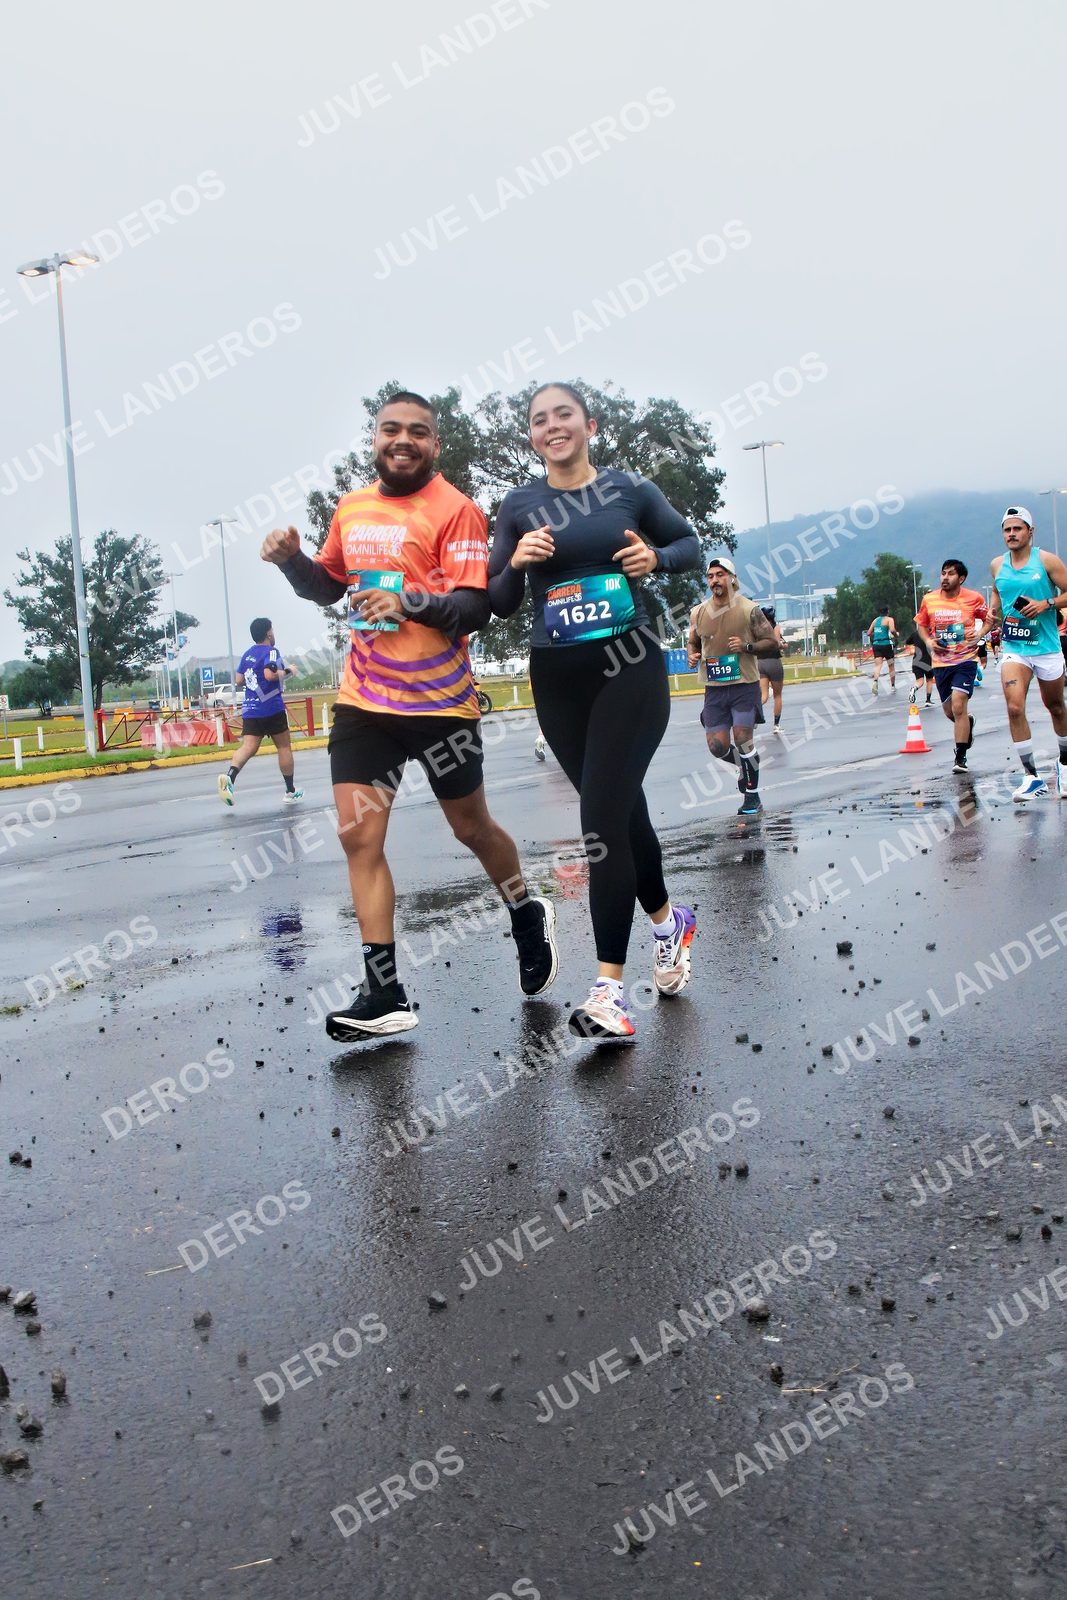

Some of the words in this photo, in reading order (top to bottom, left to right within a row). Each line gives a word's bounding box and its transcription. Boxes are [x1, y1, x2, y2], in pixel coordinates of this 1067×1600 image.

[348, 524, 407, 542] CARRERA
[379, 575, 396, 588] 10K
[604, 578, 621, 591] 10K
[547, 583, 582, 600] CARRERA
[559, 600, 612, 626] 1622
[1007, 626, 1030, 637] 1580
[711, 665, 732, 675] 1519
